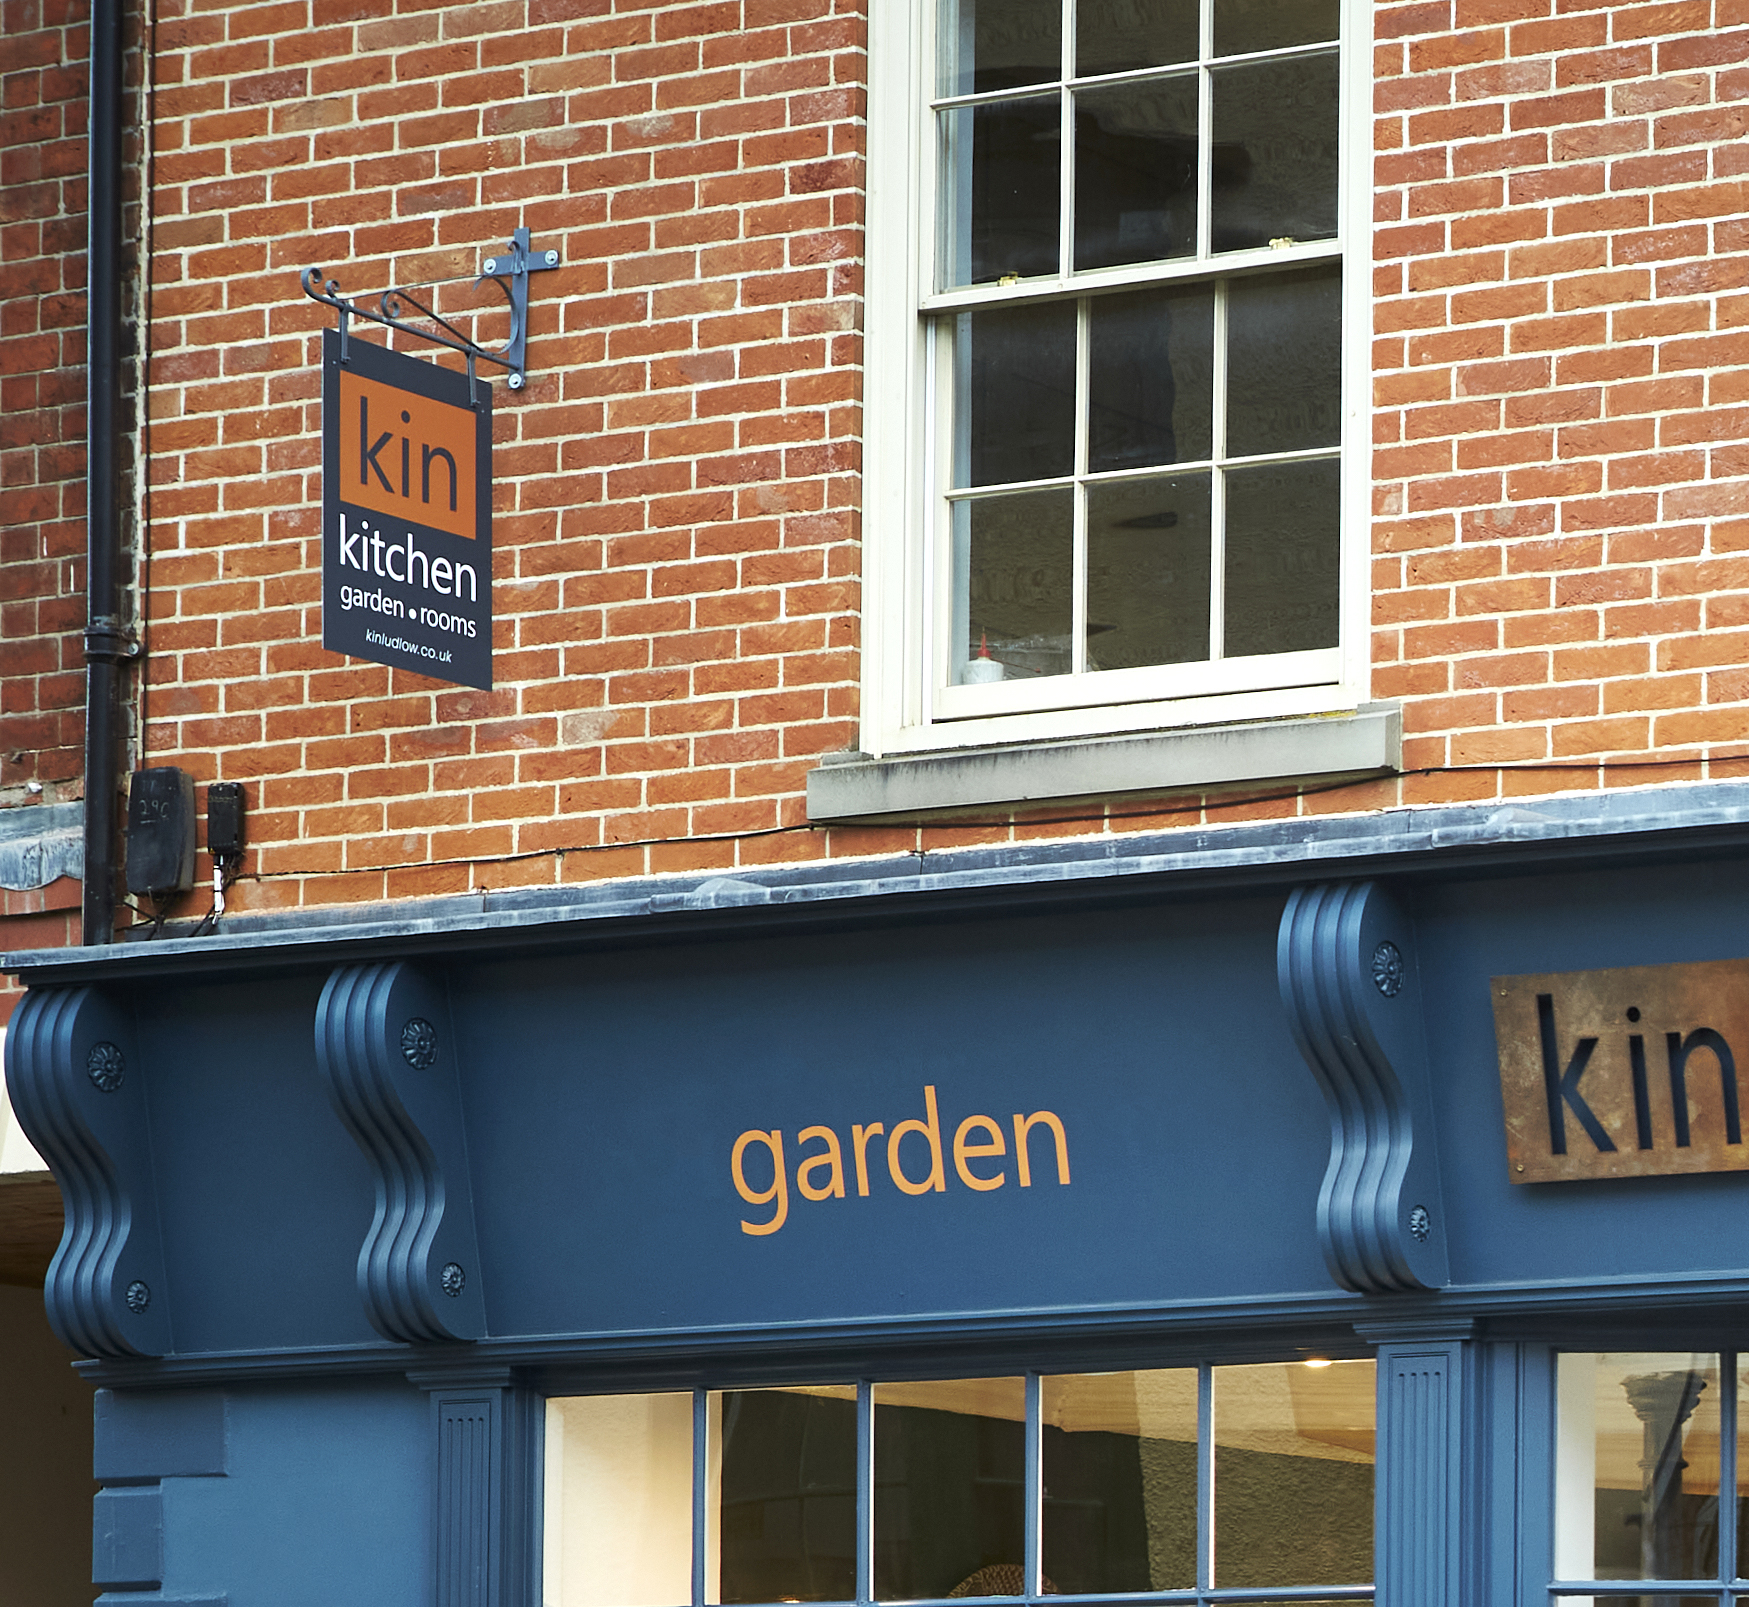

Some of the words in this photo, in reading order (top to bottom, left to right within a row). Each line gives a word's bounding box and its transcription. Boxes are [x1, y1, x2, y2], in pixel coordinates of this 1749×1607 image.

[359, 395, 458, 512] kin
[339, 512, 477, 602] kitchen
[340, 585, 405, 618] garden
[420, 607, 477, 638] rooms
[365, 628, 452, 663] kinludlow.co.uk
[1536, 992, 1743, 1156] kin
[731, 1085, 1071, 1236] garden
